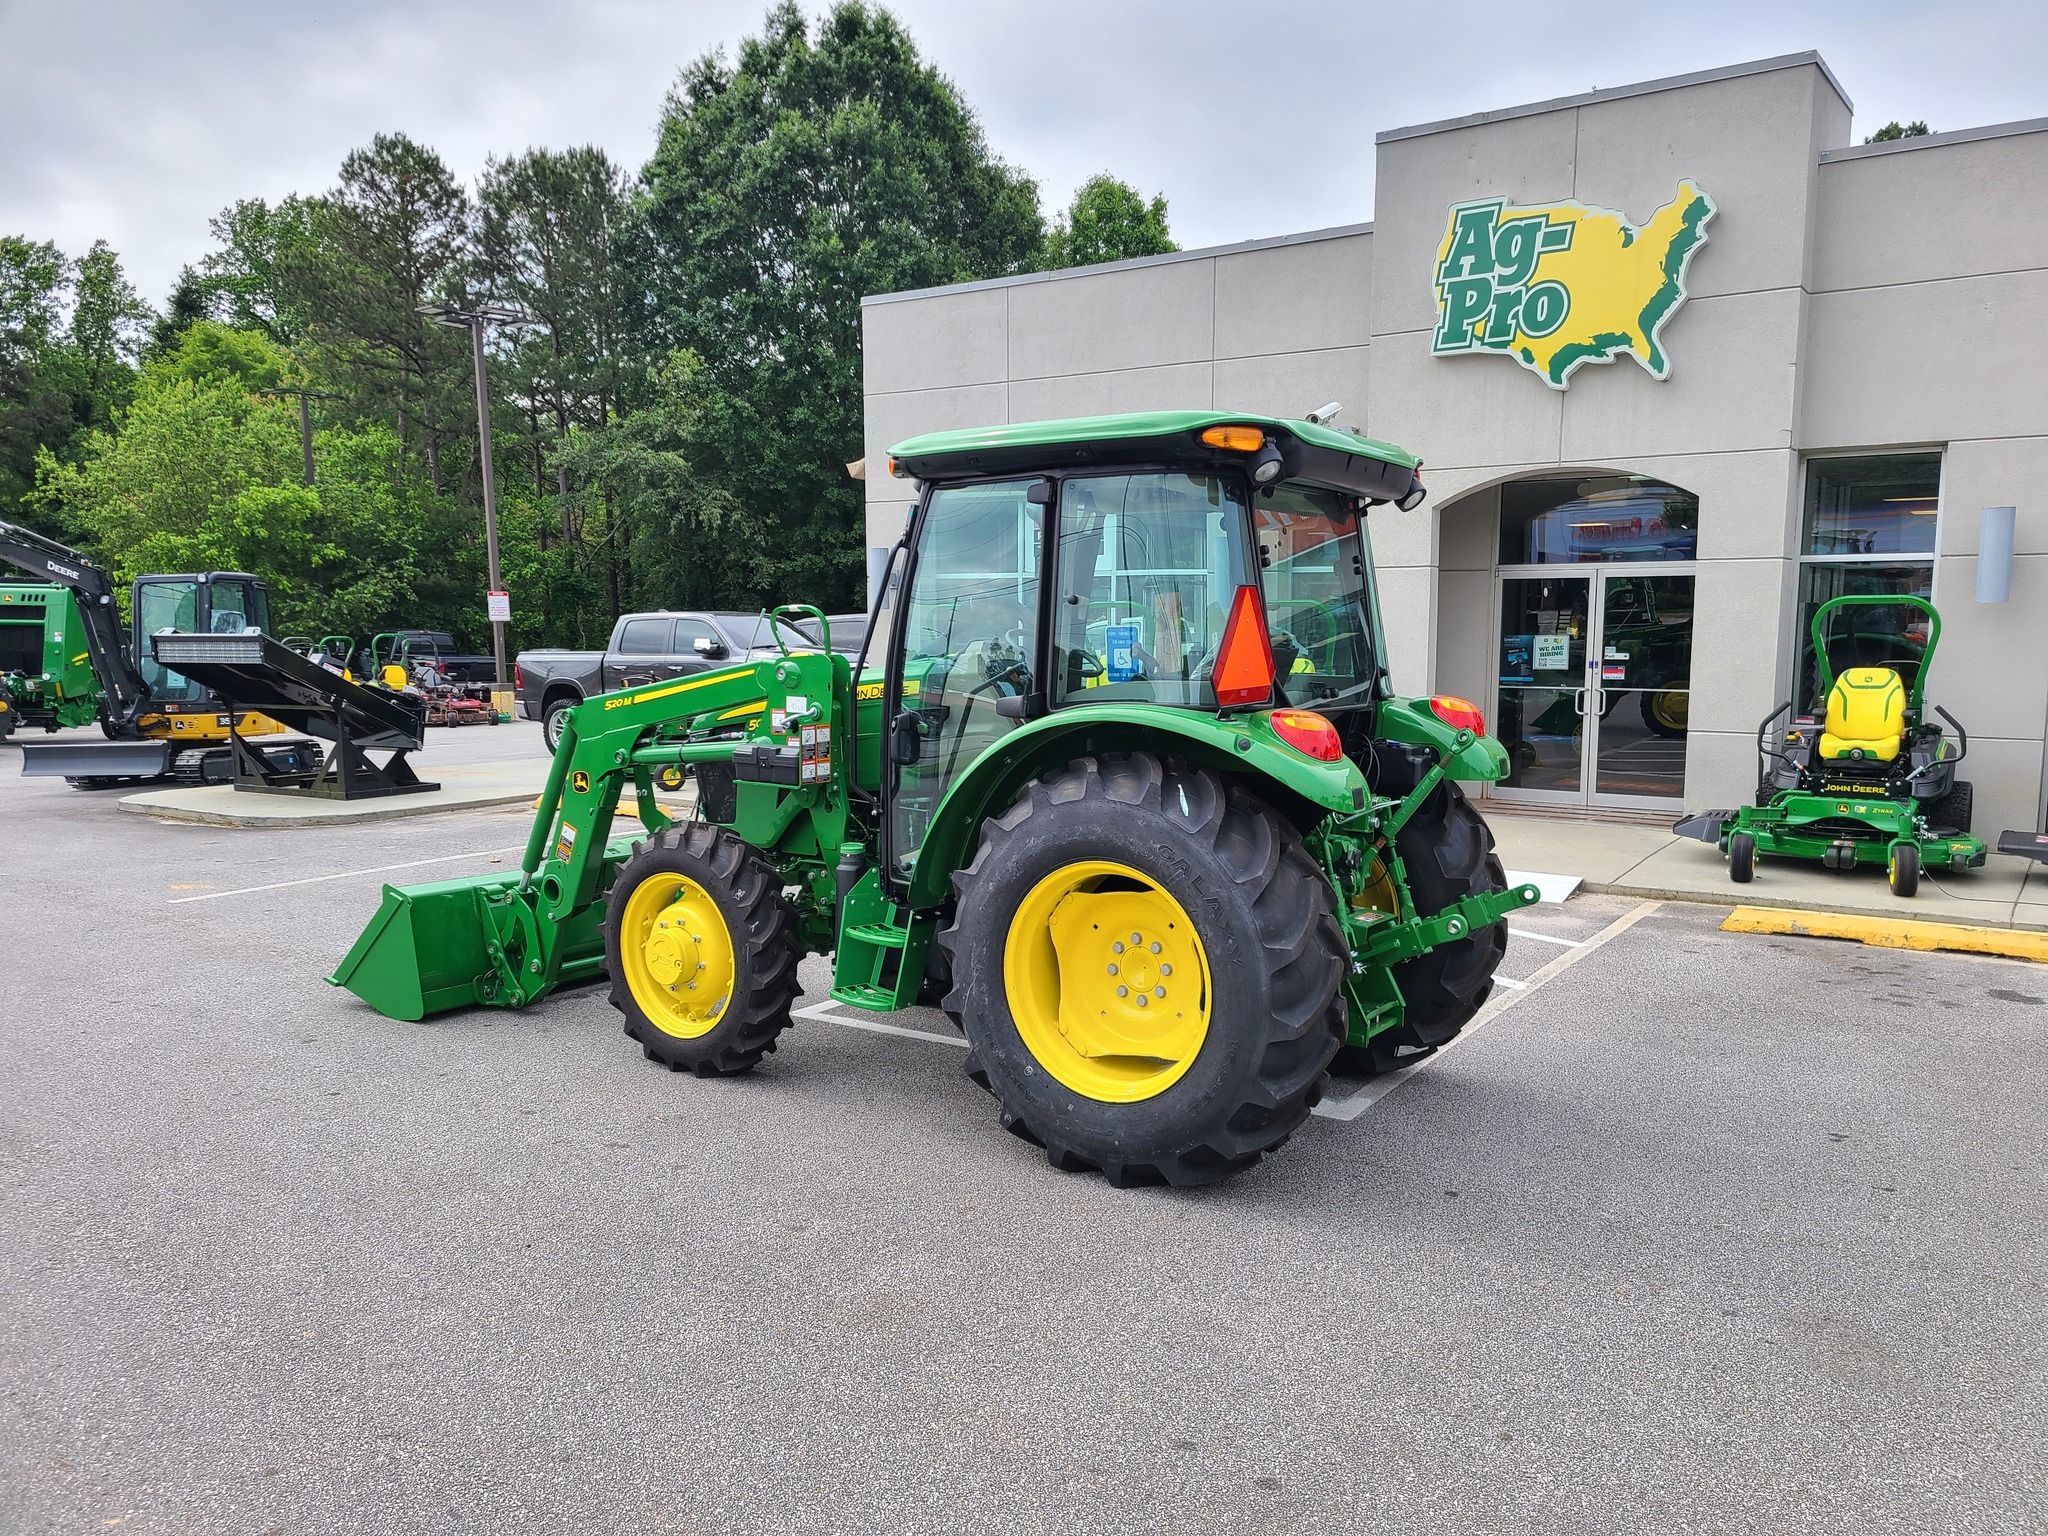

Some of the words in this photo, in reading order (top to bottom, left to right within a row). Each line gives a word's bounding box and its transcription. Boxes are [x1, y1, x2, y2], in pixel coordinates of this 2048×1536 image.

[1437, 201, 1576, 287] Ag-
[1432, 276, 1571, 352] Pro
[47, 560, 79, 580] DEERE
[1825, 784, 1850, 792] JOHN
[1852, 785, 1886, 794] DEERE
[1156, 843, 1245, 967] GALAXY
